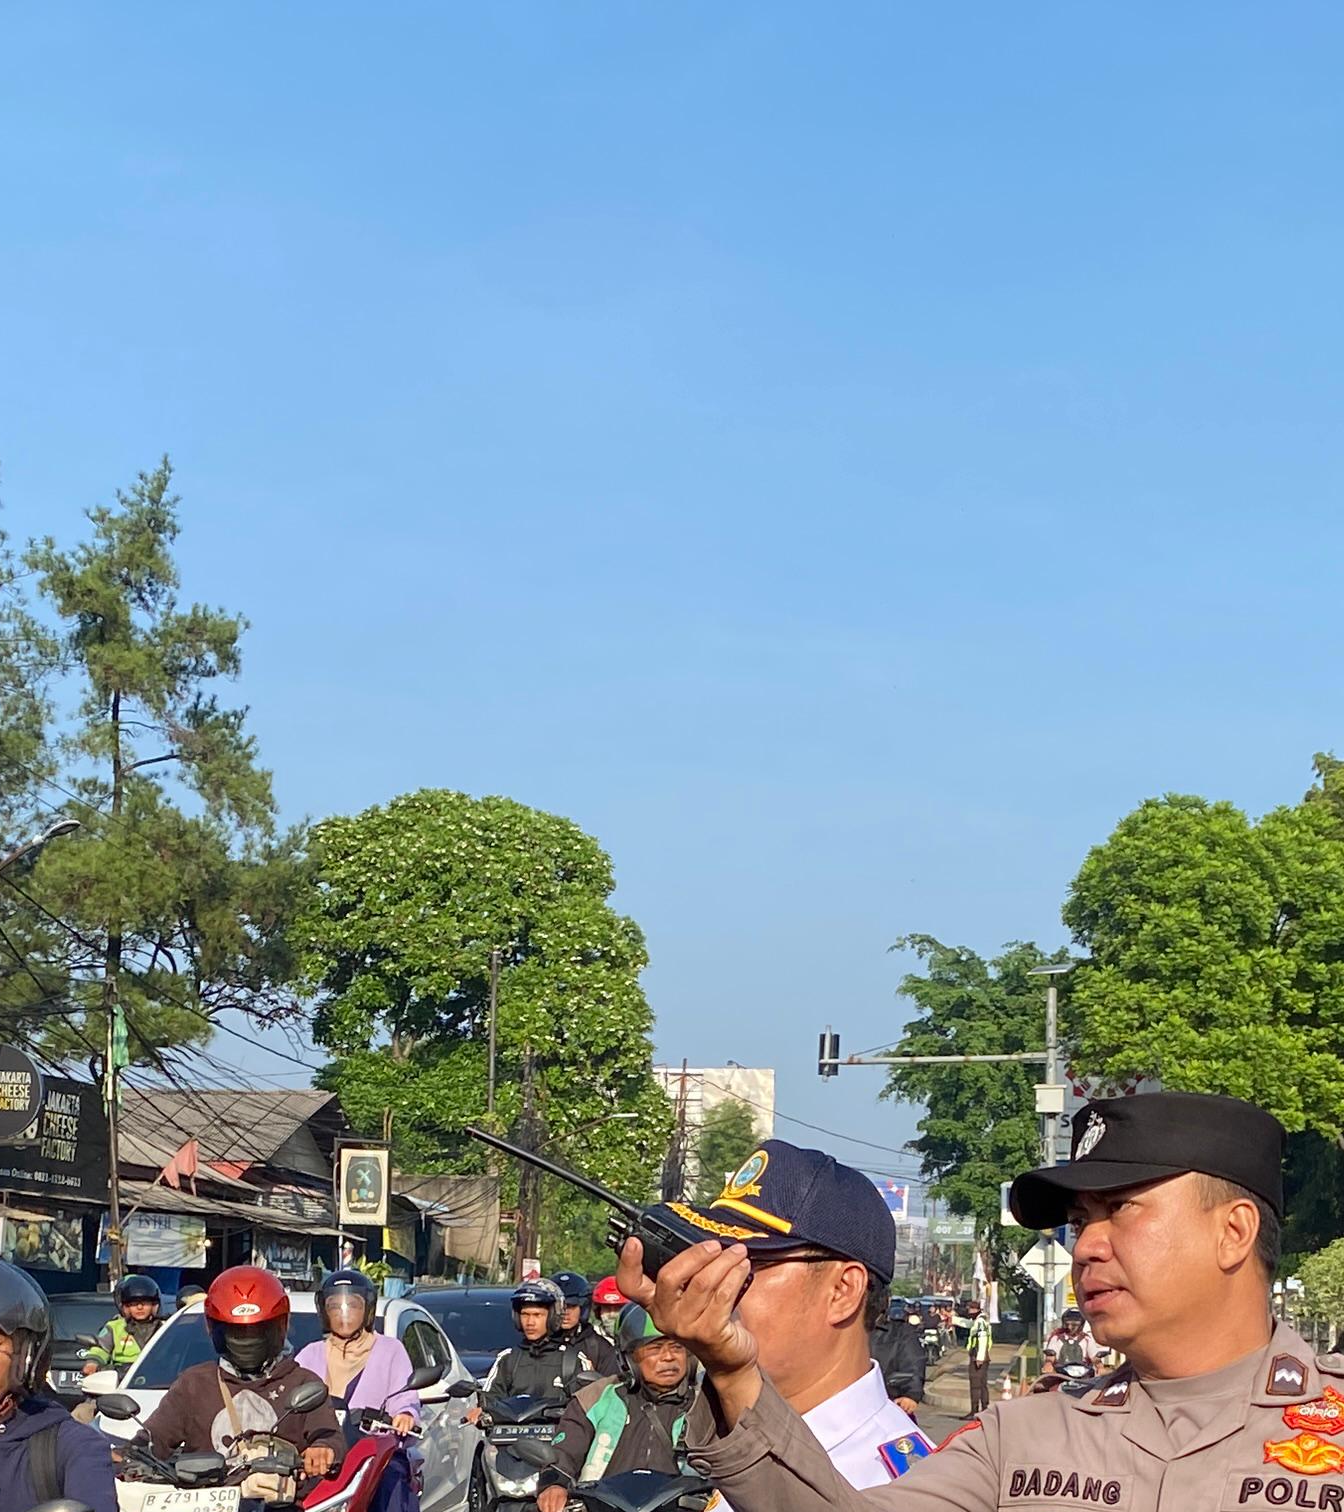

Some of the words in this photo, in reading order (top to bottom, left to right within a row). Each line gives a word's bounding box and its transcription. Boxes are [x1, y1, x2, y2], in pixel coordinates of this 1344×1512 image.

[44, 1090, 80, 1115] JAKARTA
[42, 1111, 79, 1140] CHEESE
[40, 1137, 77, 1162] FACTORY
[147, 1495, 156, 1505] B
[164, 1492, 199, 1504] 4791
[1009, 1468, 1121, 1504] DADANG
